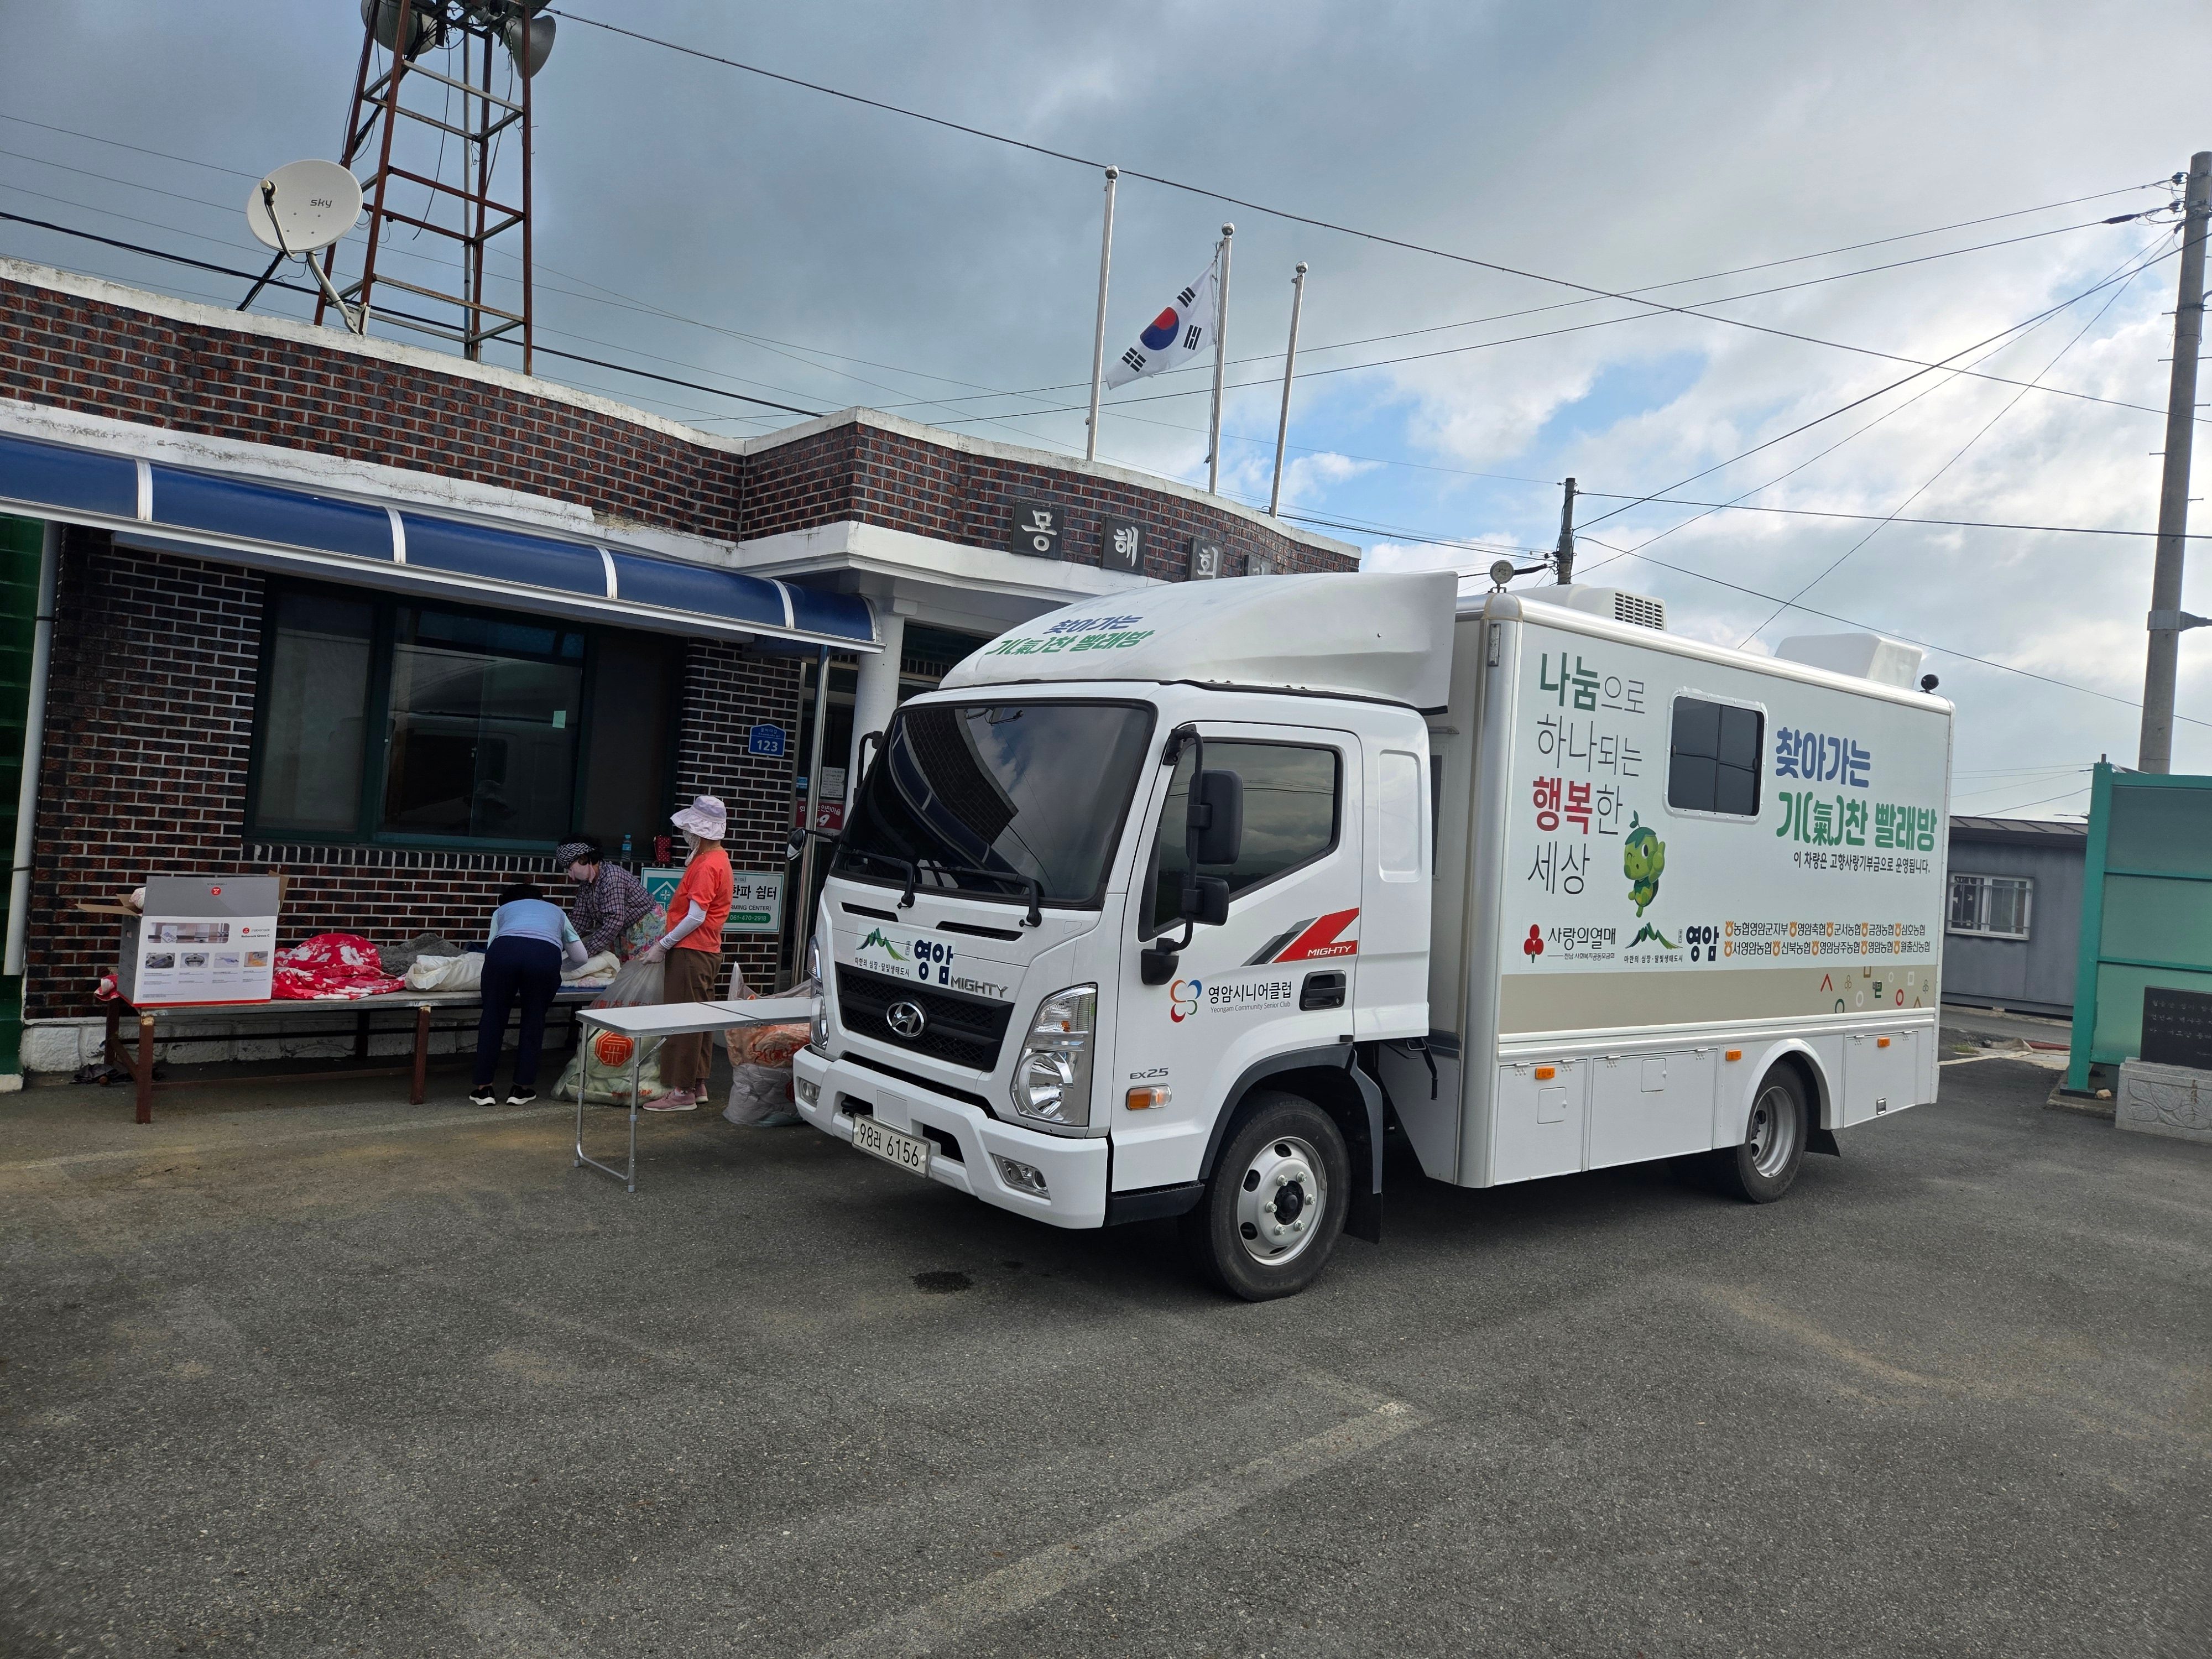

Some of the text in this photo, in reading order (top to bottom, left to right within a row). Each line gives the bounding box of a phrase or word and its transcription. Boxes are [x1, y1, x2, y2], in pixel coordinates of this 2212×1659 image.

[310, 199, 332, 208] sky
[1043, 615, 1143, 634] 찾아가는
[984, 630, 1155, 655] 기(氣)찬 빨래방
[1540, 651, 1645, 714] 나눔으로
[757, 740, 778, 752] 123
[1537, 713, 1642, 777] 하나되는
[1776, 727, 1871, 788] 찾아가는
[1533, 776, 1623, 835] 행복한
[1776, 791, 1937, 852] 기(氣)찬 빨래방
[1527, 841, 1590, 895] 세상
[1793, 852, 1931, 874] 이 차량은 고향사랑기부금으로 운영됩니다.
[755, 885, 777, 900] 쉼터
[1548, 927, 1616, 951] 사랑의열매
[1734, 922, 1926, 936] 농협영암군지부 영암축협 군서농협 금정농협 삼호농협
[1307, 945, 1353, 957] MIGHTY
[1686, 926, 1719, 962] 영암
[1733, 941, 1930, 956] 서영암농협 신북농협 영암낭주농협 영암농협 월출산농협
[855, 957, 868, 967] 마한의
[914, 939, 953, 985] 영암
[1574, 953, 1615, 961] 사회복지공동모금회
[1624, 955, 1639, 963] 마한의
[951, 975, 1009, 998] MIGHTY
[1208, 981, 1291, 1004] 영암시니어클럽
[1235, 1003, 1263, 1011] Community
[1130, 1067, 1168, 1079] EX25
[860, 1123, 919, 1167] 98러 6156
